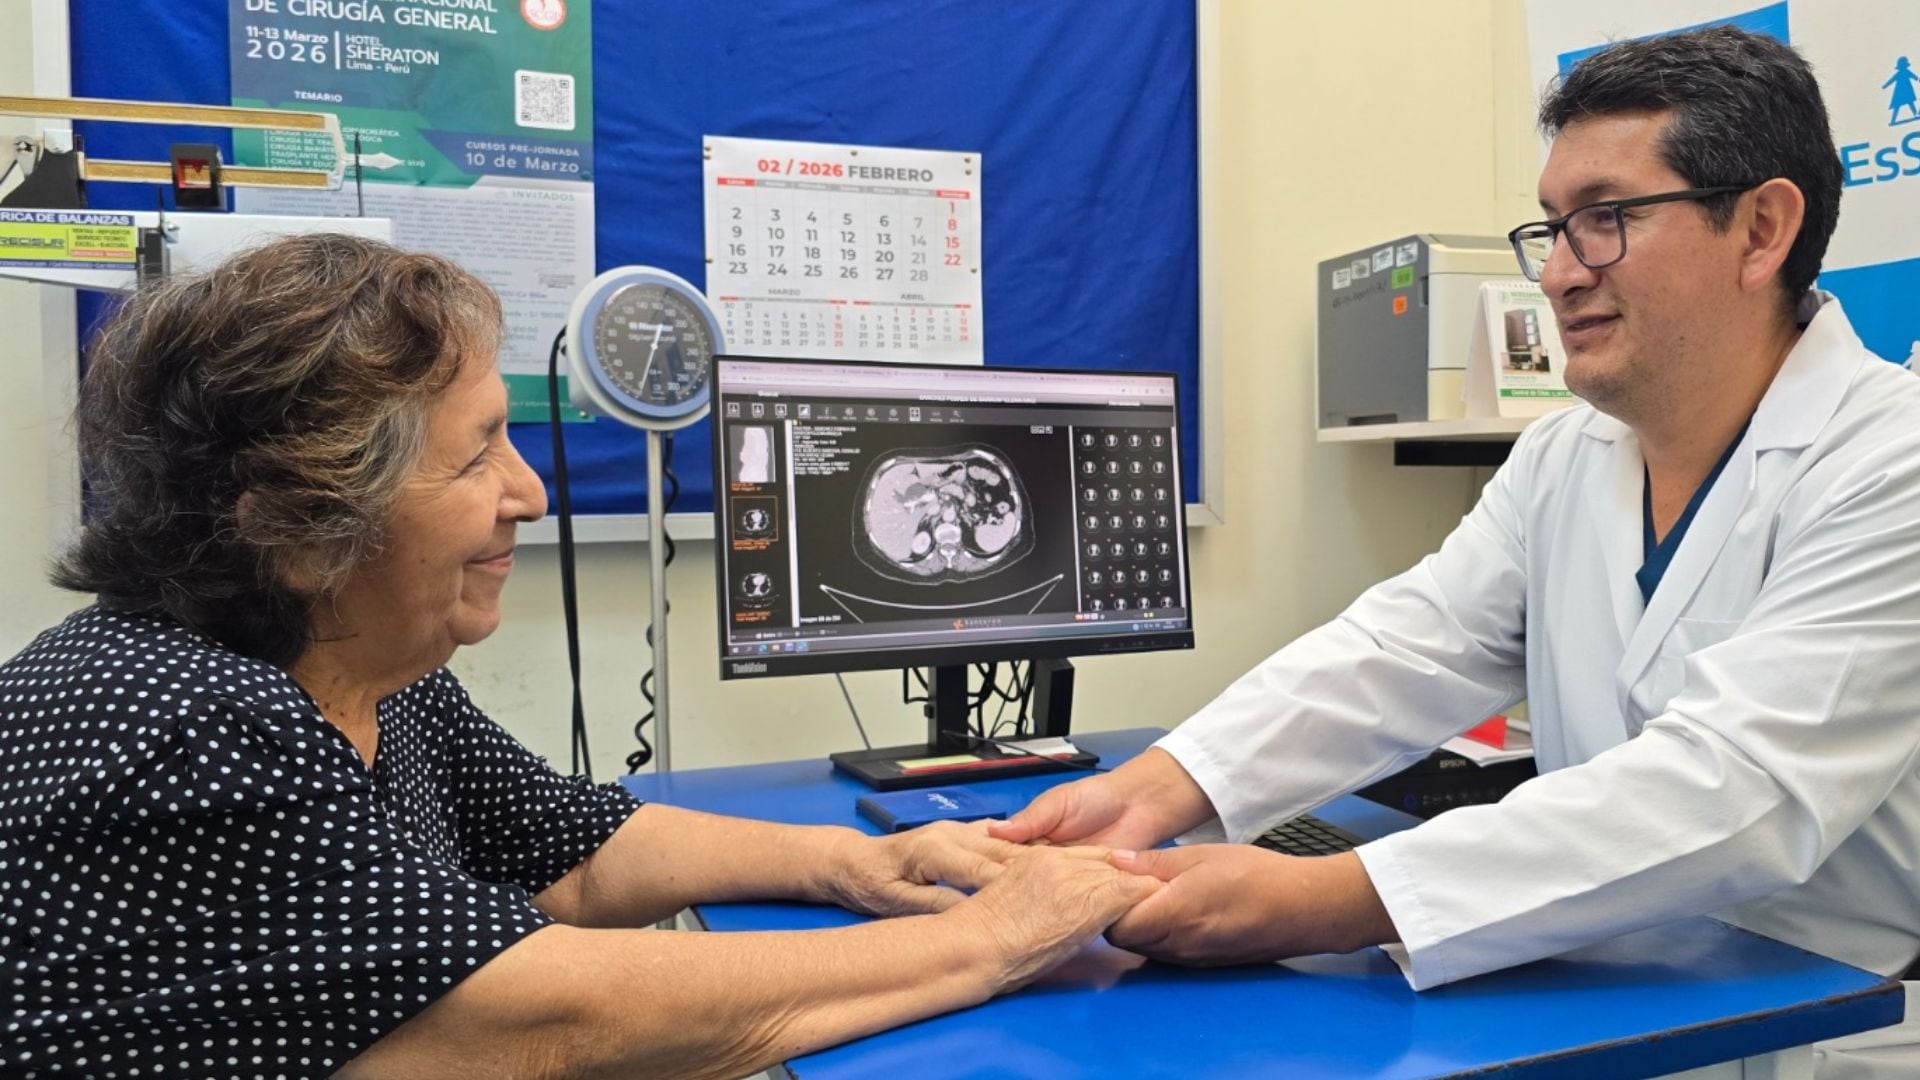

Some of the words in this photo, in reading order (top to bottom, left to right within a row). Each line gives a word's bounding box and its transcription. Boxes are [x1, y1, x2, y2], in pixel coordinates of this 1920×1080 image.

[246, 0, 278, 13] DE
[288, 0, 385, 23] CIRUGÍA
[395, 7, 497, 34] GENERAL
[246, 26, 279, 39] 11-13
[284, 30, 328, 43] Marzo
[346, 35, 383, 46] HOTEL
[246, 40, 326, 63] 2026
[346, 45, 439, 65] SHERATON
[346, 60, 373, 70] Lima
[385, 63, 410, 73] Perú
[294, 91, 342, 102] TEMARIO
[465, 141, 506, 151] CURSOS
[510, 144, 579, 157] PRE-JORNADA
[466, 153, 485, 166] 10
[494, 154, 517, 168] de
[525, 157, 579, 172] Marzo
[758, 160, 780, 173] 02
[787, 159, 794, 174] /
[801, 163, 843, 177] 2026
[848, 166, 933, 182] FEBRERO
[512, 191, 575, 201] INVITADOS
[950, 201, 954, 214] 1
[0, 211, 33, 221] RICA
[36, 212, 56, 222] DE
[58, 213, 129, 224] BALANZAS
[732, 207, 741, 219] 2
[771, 209, 780, 221] 3
[807, 212, 816, 223] 4
[844, 213, 852, 225] 5
[880, 215, 889, 227] 6
[914, 217, 923, 228] 7
[948, 218, 957, 231] 8
[732, 226, 742, 238] 9
[768, 227, 784, 240] 10
[806, 229, 817, 241] 11
[841, 231, 855, 243] 12
[877, 233, 892, 245] 13
[911, 234, 927, 246] 14
[945, 236, 960, 248] 15
[729, 244, 746, 256] 16
[768, 245, 784, 258] 17
[804, 247, 820, 259] 18
[841, 248, 856, 261] 19
[875, 251, 894, 263] 20
[912, 252, 926, 264] 21
[944, 254, 961, 266] 22
[729, 262, 747, 274] 23
[768, 263, 787, 275] 24
[804, 265, 822, 277] 25
[840, 266, 858, 279] 26
[876, 268, 894, 280] 27
[910, 269, 928, 281] 28
[1440, 760, 1466, 769] EPSON
